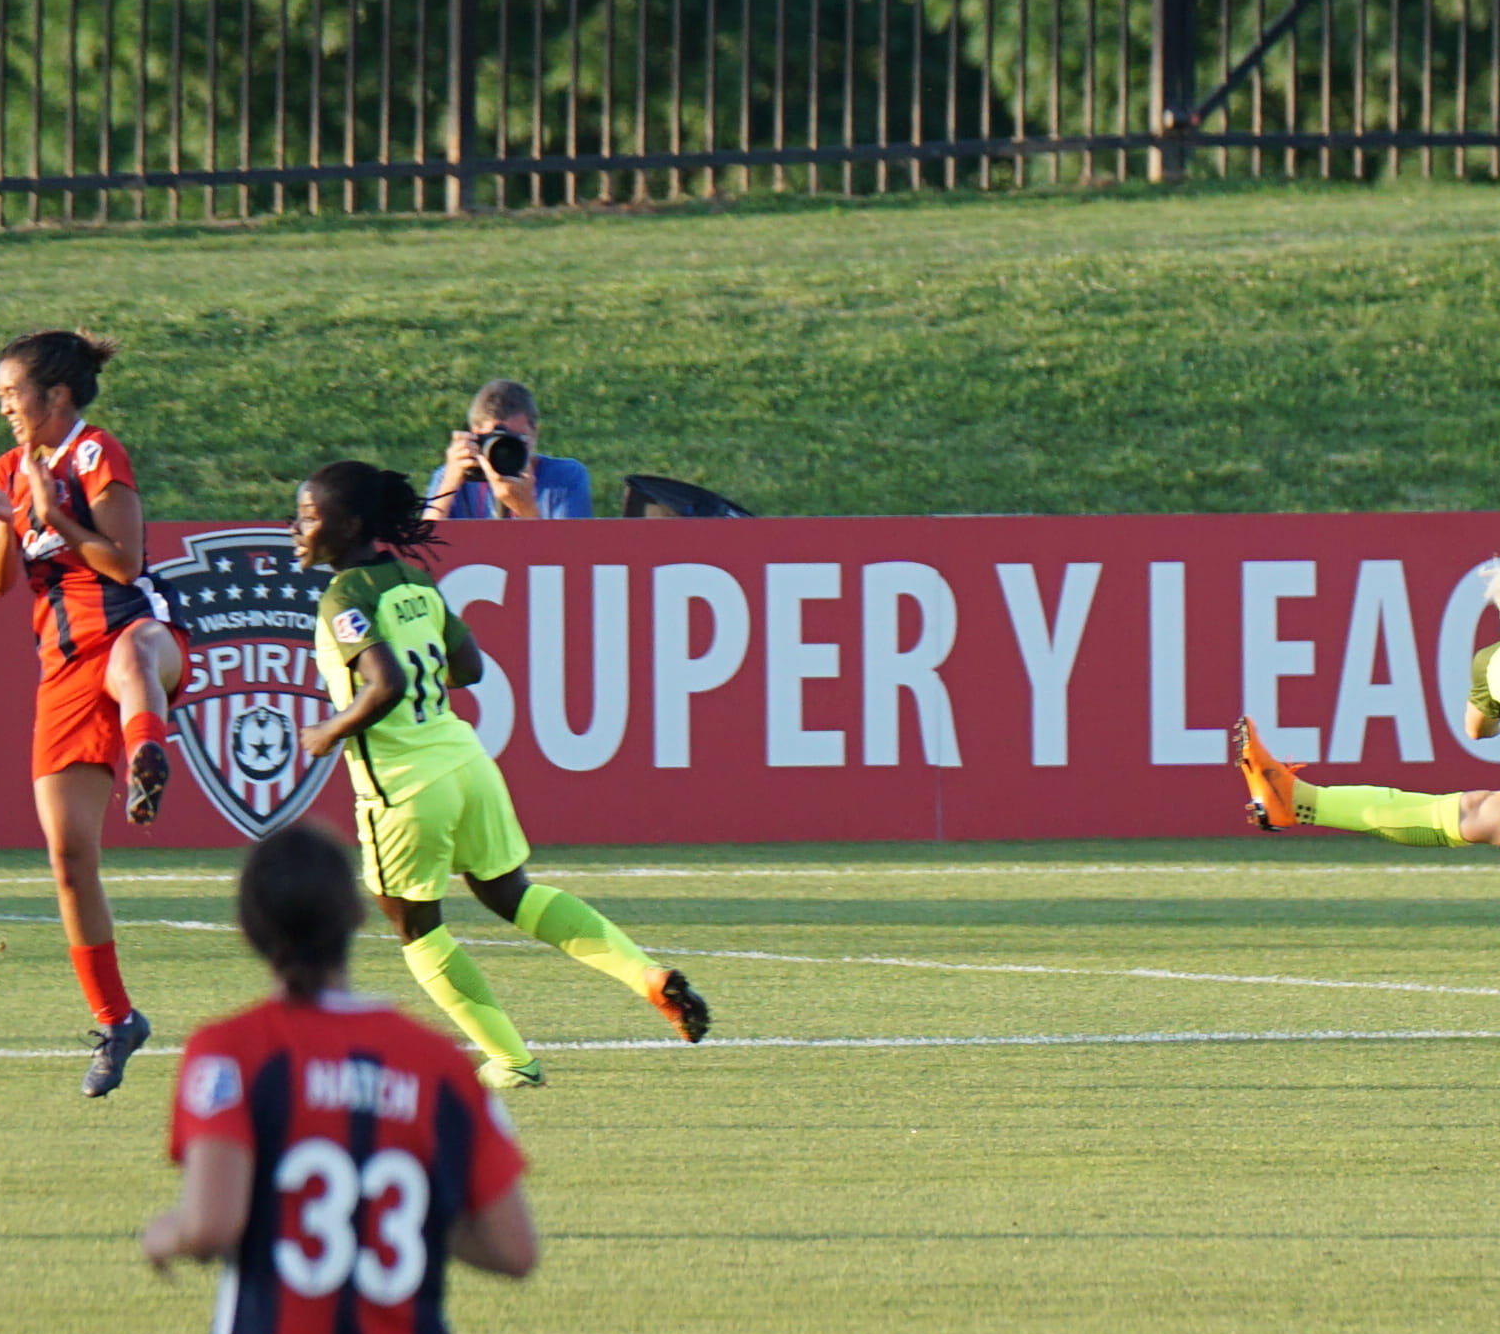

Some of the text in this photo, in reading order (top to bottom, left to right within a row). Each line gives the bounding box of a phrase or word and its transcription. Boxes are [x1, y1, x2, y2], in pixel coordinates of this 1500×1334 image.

[196, 609, 316, 634] WASHINGTO
[406, 642, 447, 724] 11
[436, 561, 963, 771] SUPER
[995, 562, 1103, 766] Y
[304, 1056, 419, 1125] HATCH
[271, 1135, 431, 1307] 33
